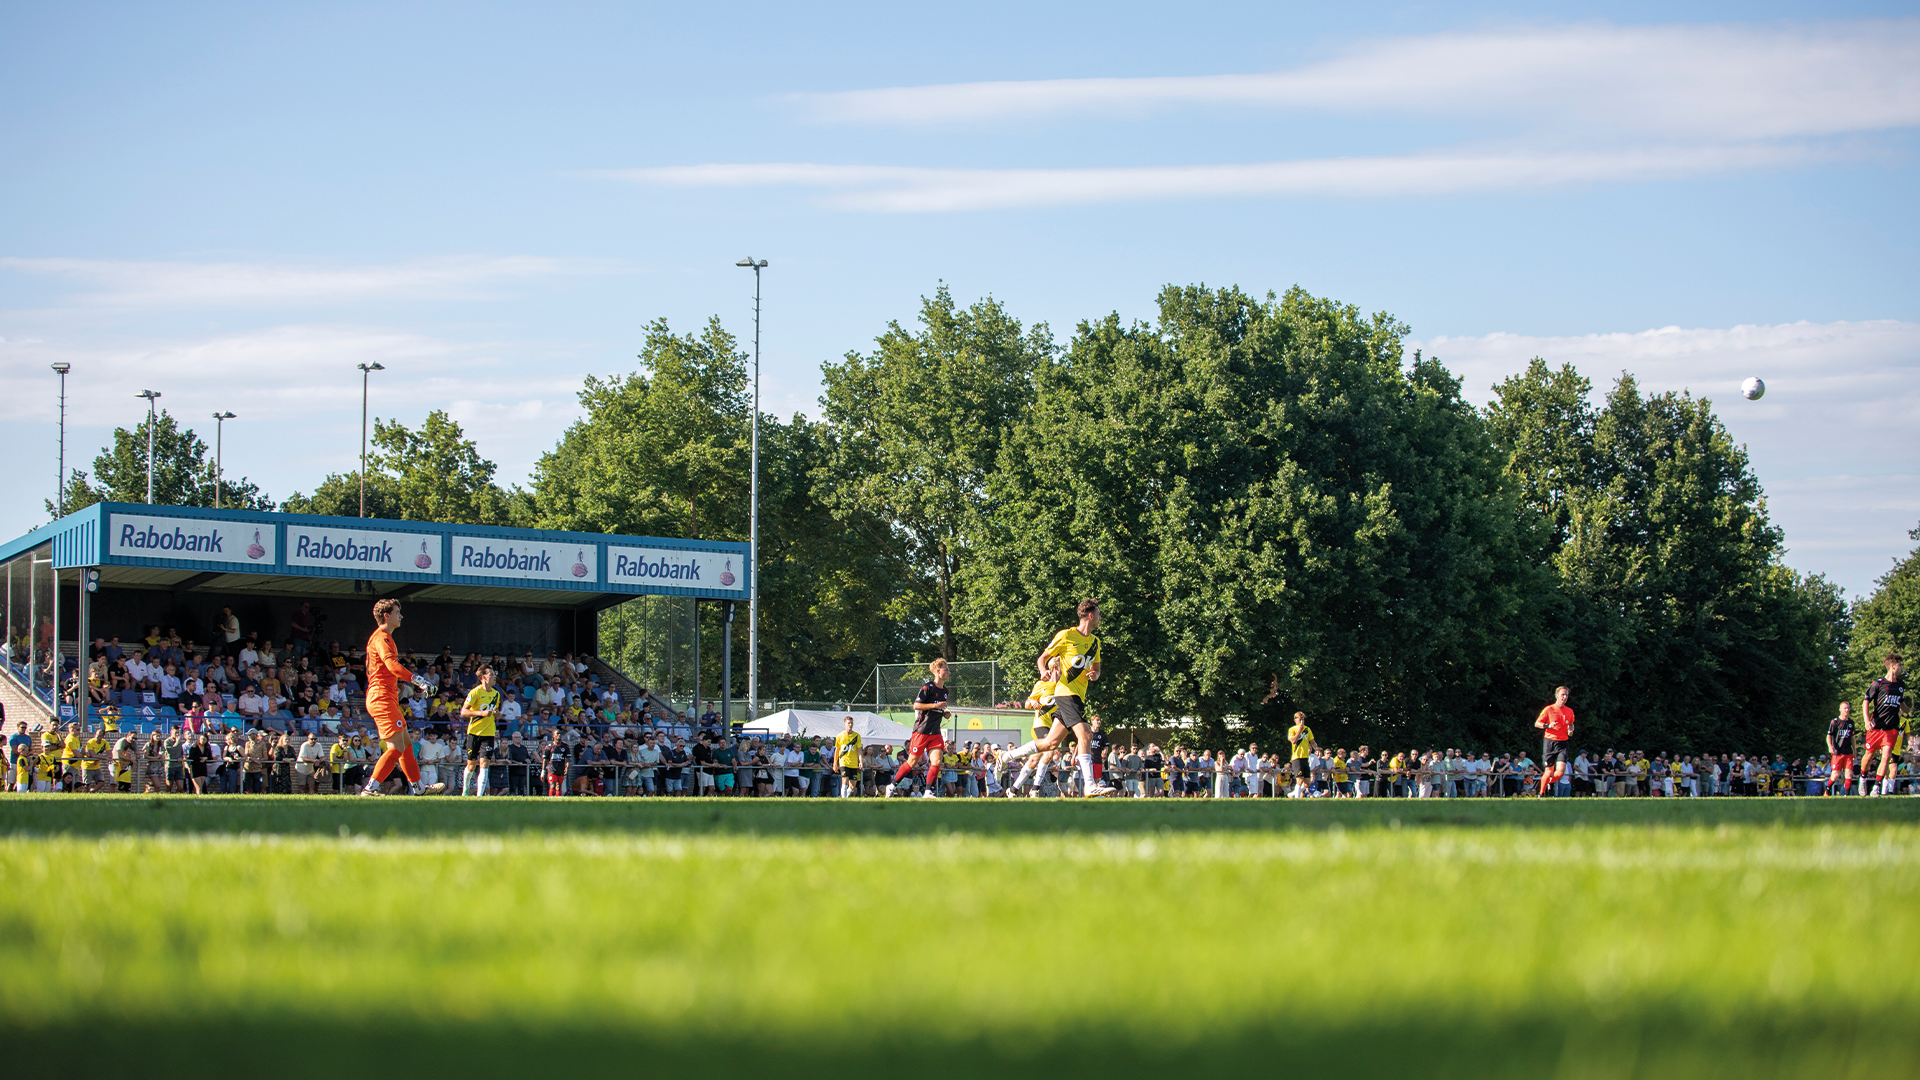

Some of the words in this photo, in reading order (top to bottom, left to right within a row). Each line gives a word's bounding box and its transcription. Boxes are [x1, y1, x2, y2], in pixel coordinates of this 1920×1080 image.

[120, 523, 223, 553] Rabobank
[296, 535, 393, 563] Rabobank
[460, 545, 551, 572] Rabobank
[615, 554, 701, 581] Rabobank
[1071, 654, 1096, 669] OK
[841, 744, 855, 752] OK
